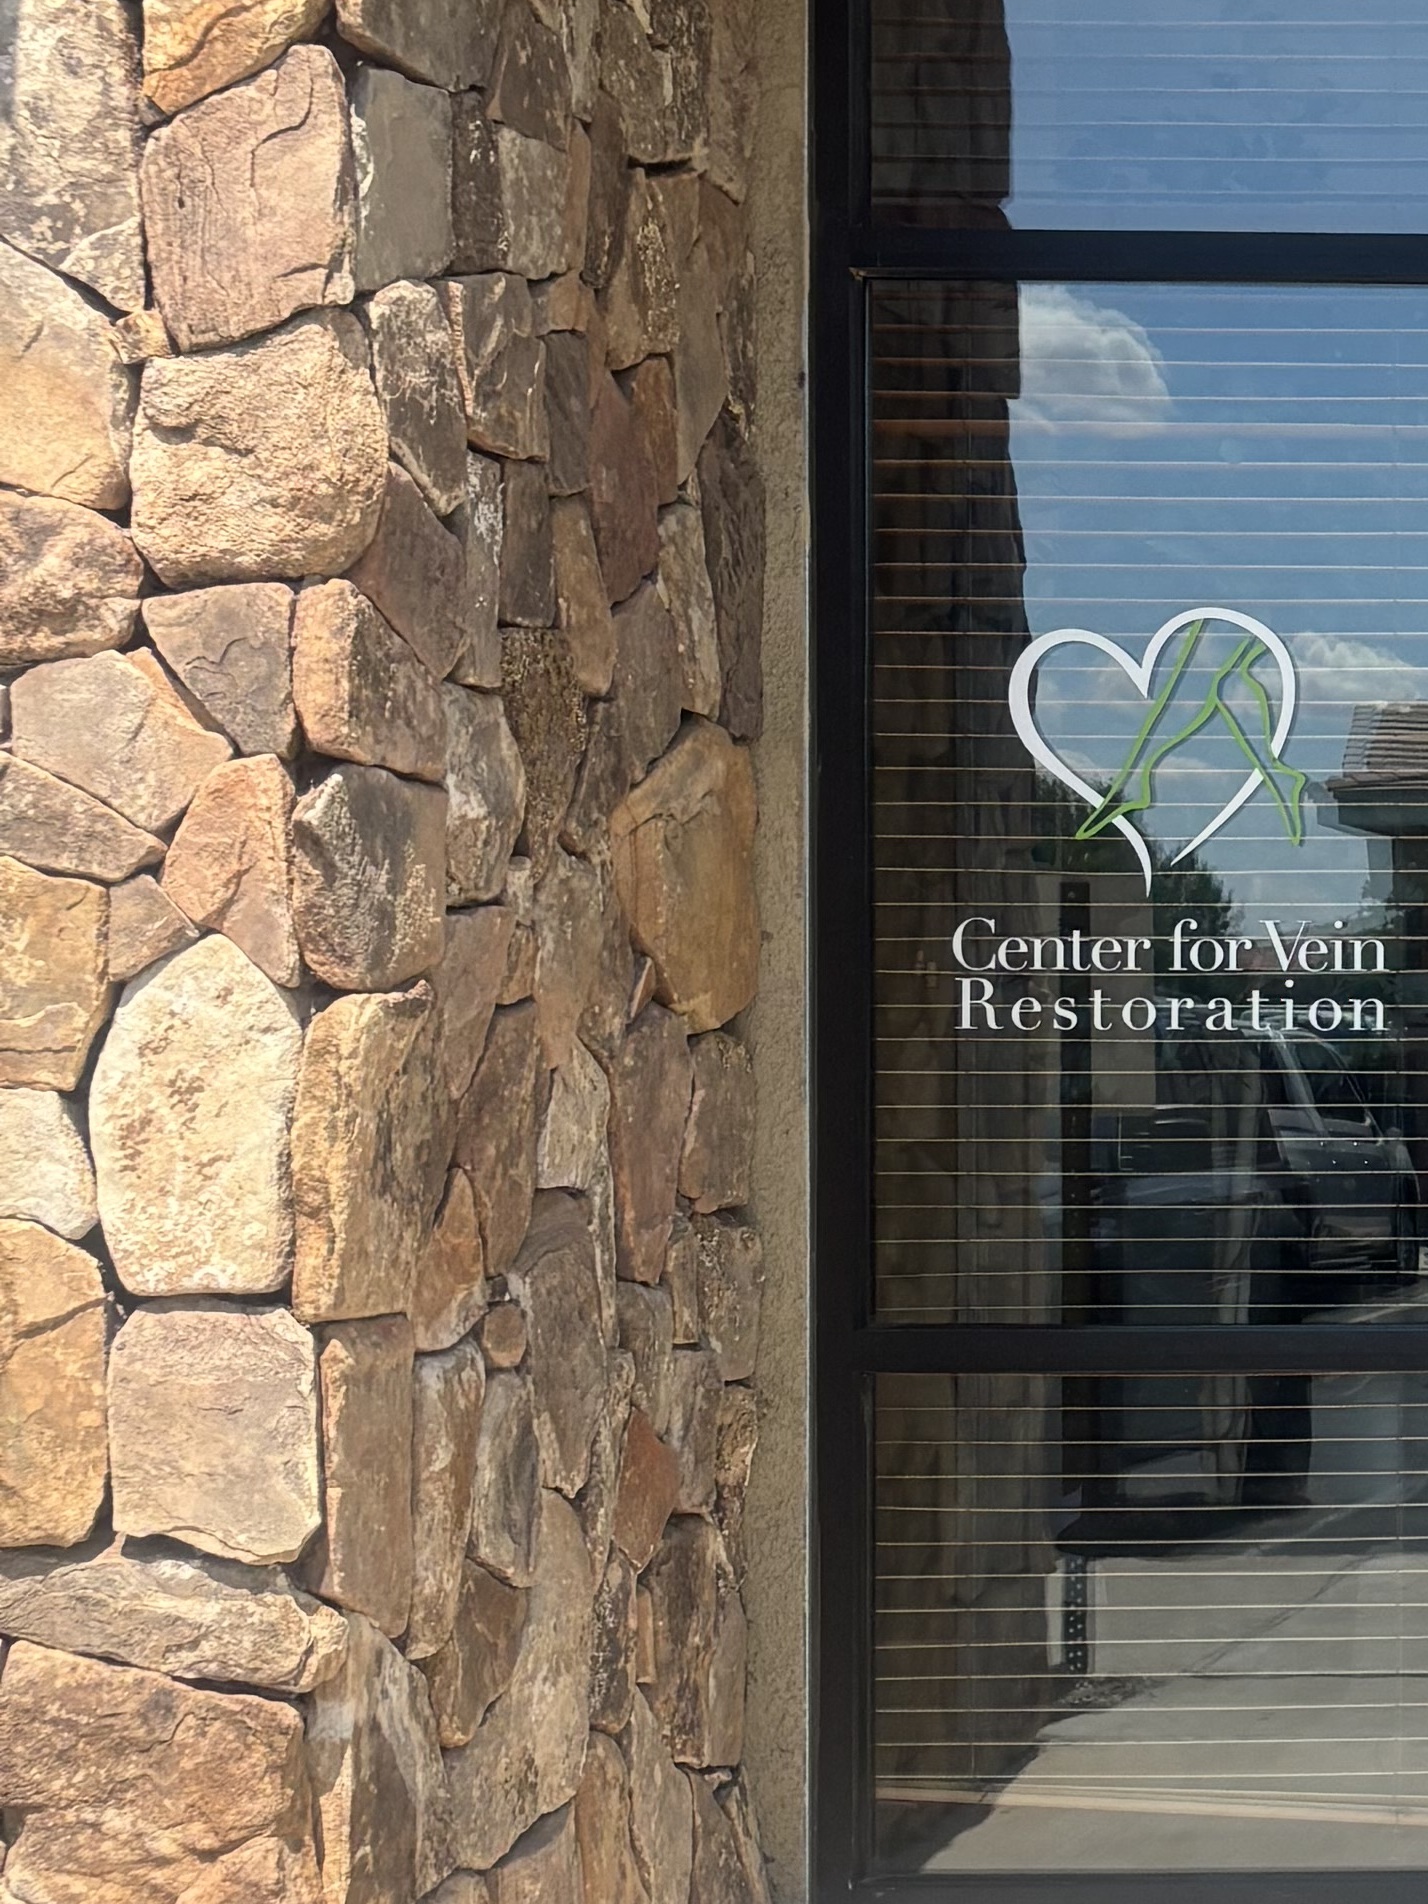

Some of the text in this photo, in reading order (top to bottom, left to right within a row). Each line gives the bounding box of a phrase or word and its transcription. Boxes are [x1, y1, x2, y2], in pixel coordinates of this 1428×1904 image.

[951, 917, 1389, 973] Center for Vein
[954, 977, 1389, 1031] Restoration
